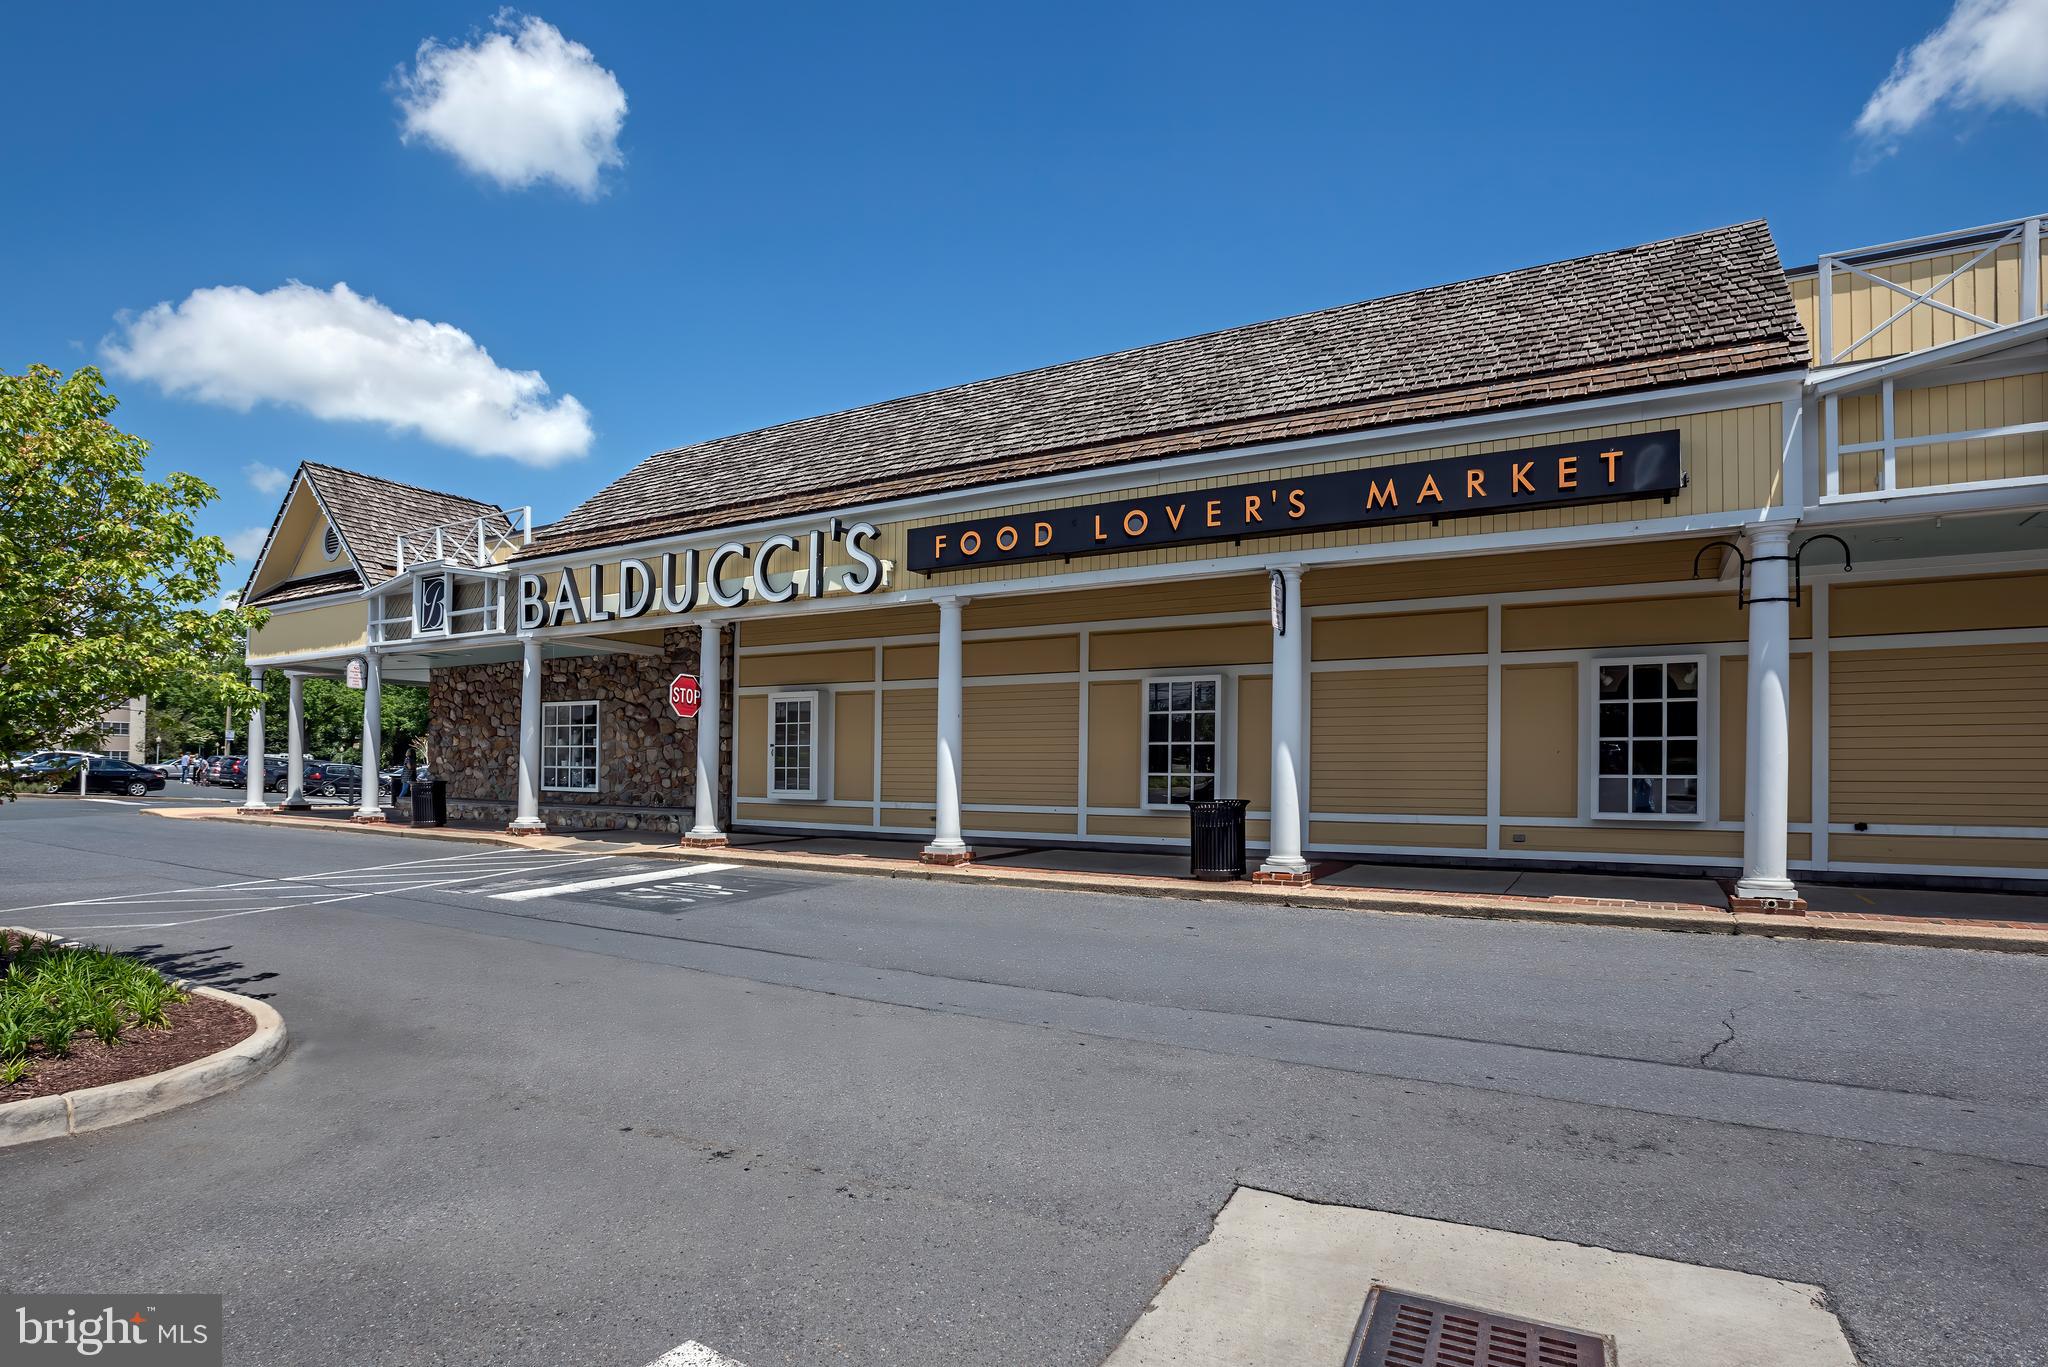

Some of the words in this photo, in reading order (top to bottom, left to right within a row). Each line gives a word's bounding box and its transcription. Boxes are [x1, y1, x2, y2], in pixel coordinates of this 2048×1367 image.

[935, 522, 1054, 559] FOOD
[1095, 489, 1306, 540] LOVER'S
[1366, 451, 1624, 509] MARKET
[519, 517, 882, 629] BALDUCCI'S
[672, 686, 701, 704] STOP
